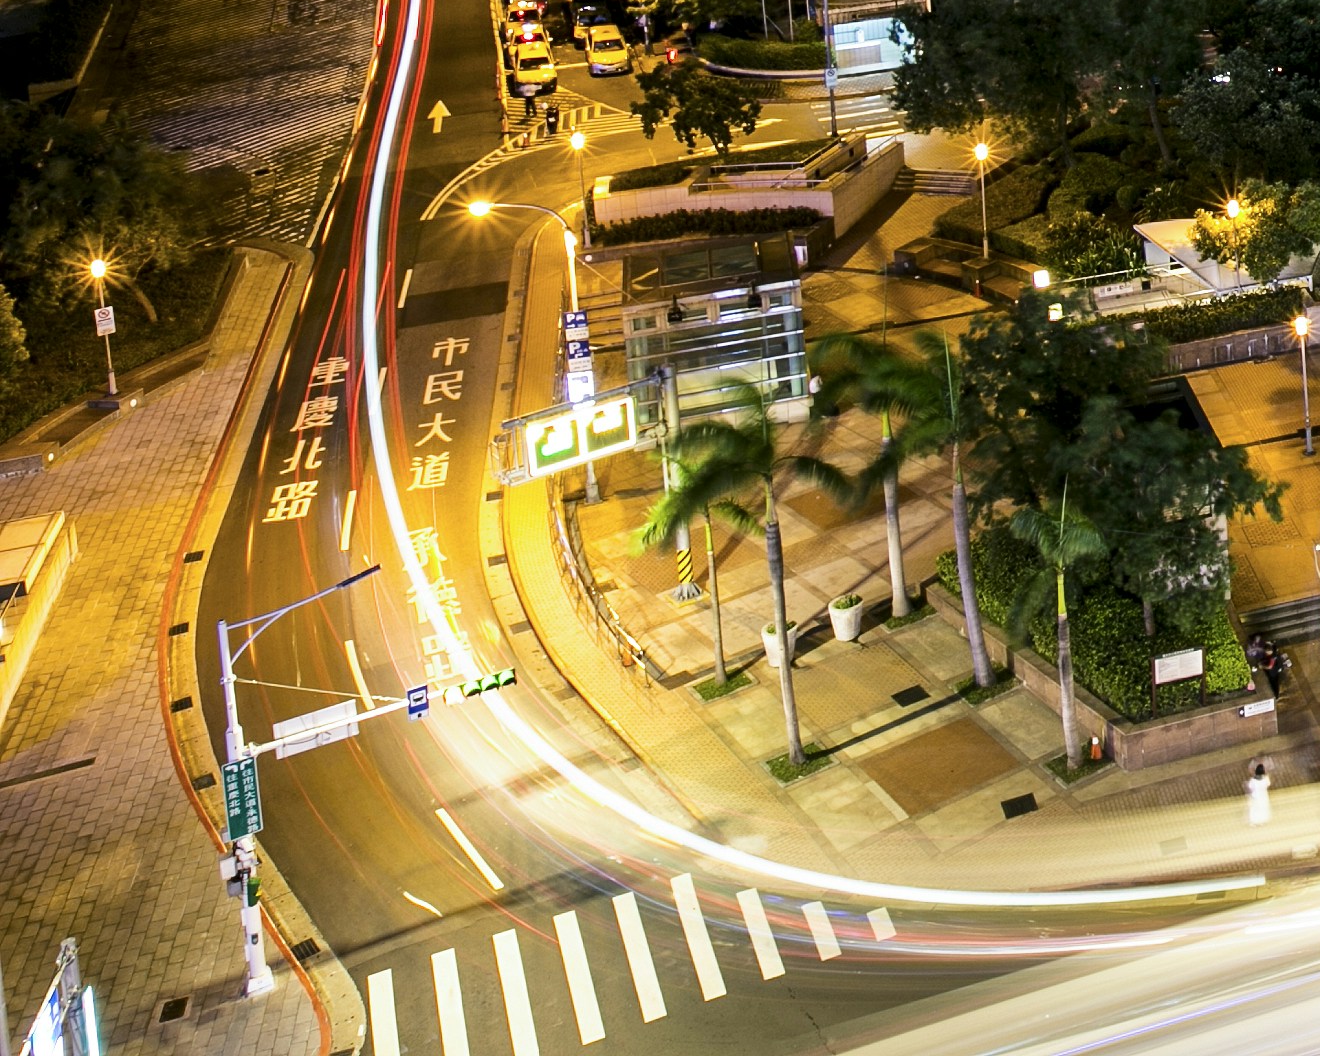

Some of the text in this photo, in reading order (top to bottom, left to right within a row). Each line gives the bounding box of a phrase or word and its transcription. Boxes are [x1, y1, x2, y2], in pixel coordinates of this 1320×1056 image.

[262, 356, 350, 523] 重慶北路
[406, 337, 471, 492] 市民大道
[226, 773, 241, 817] 往重慶北路
